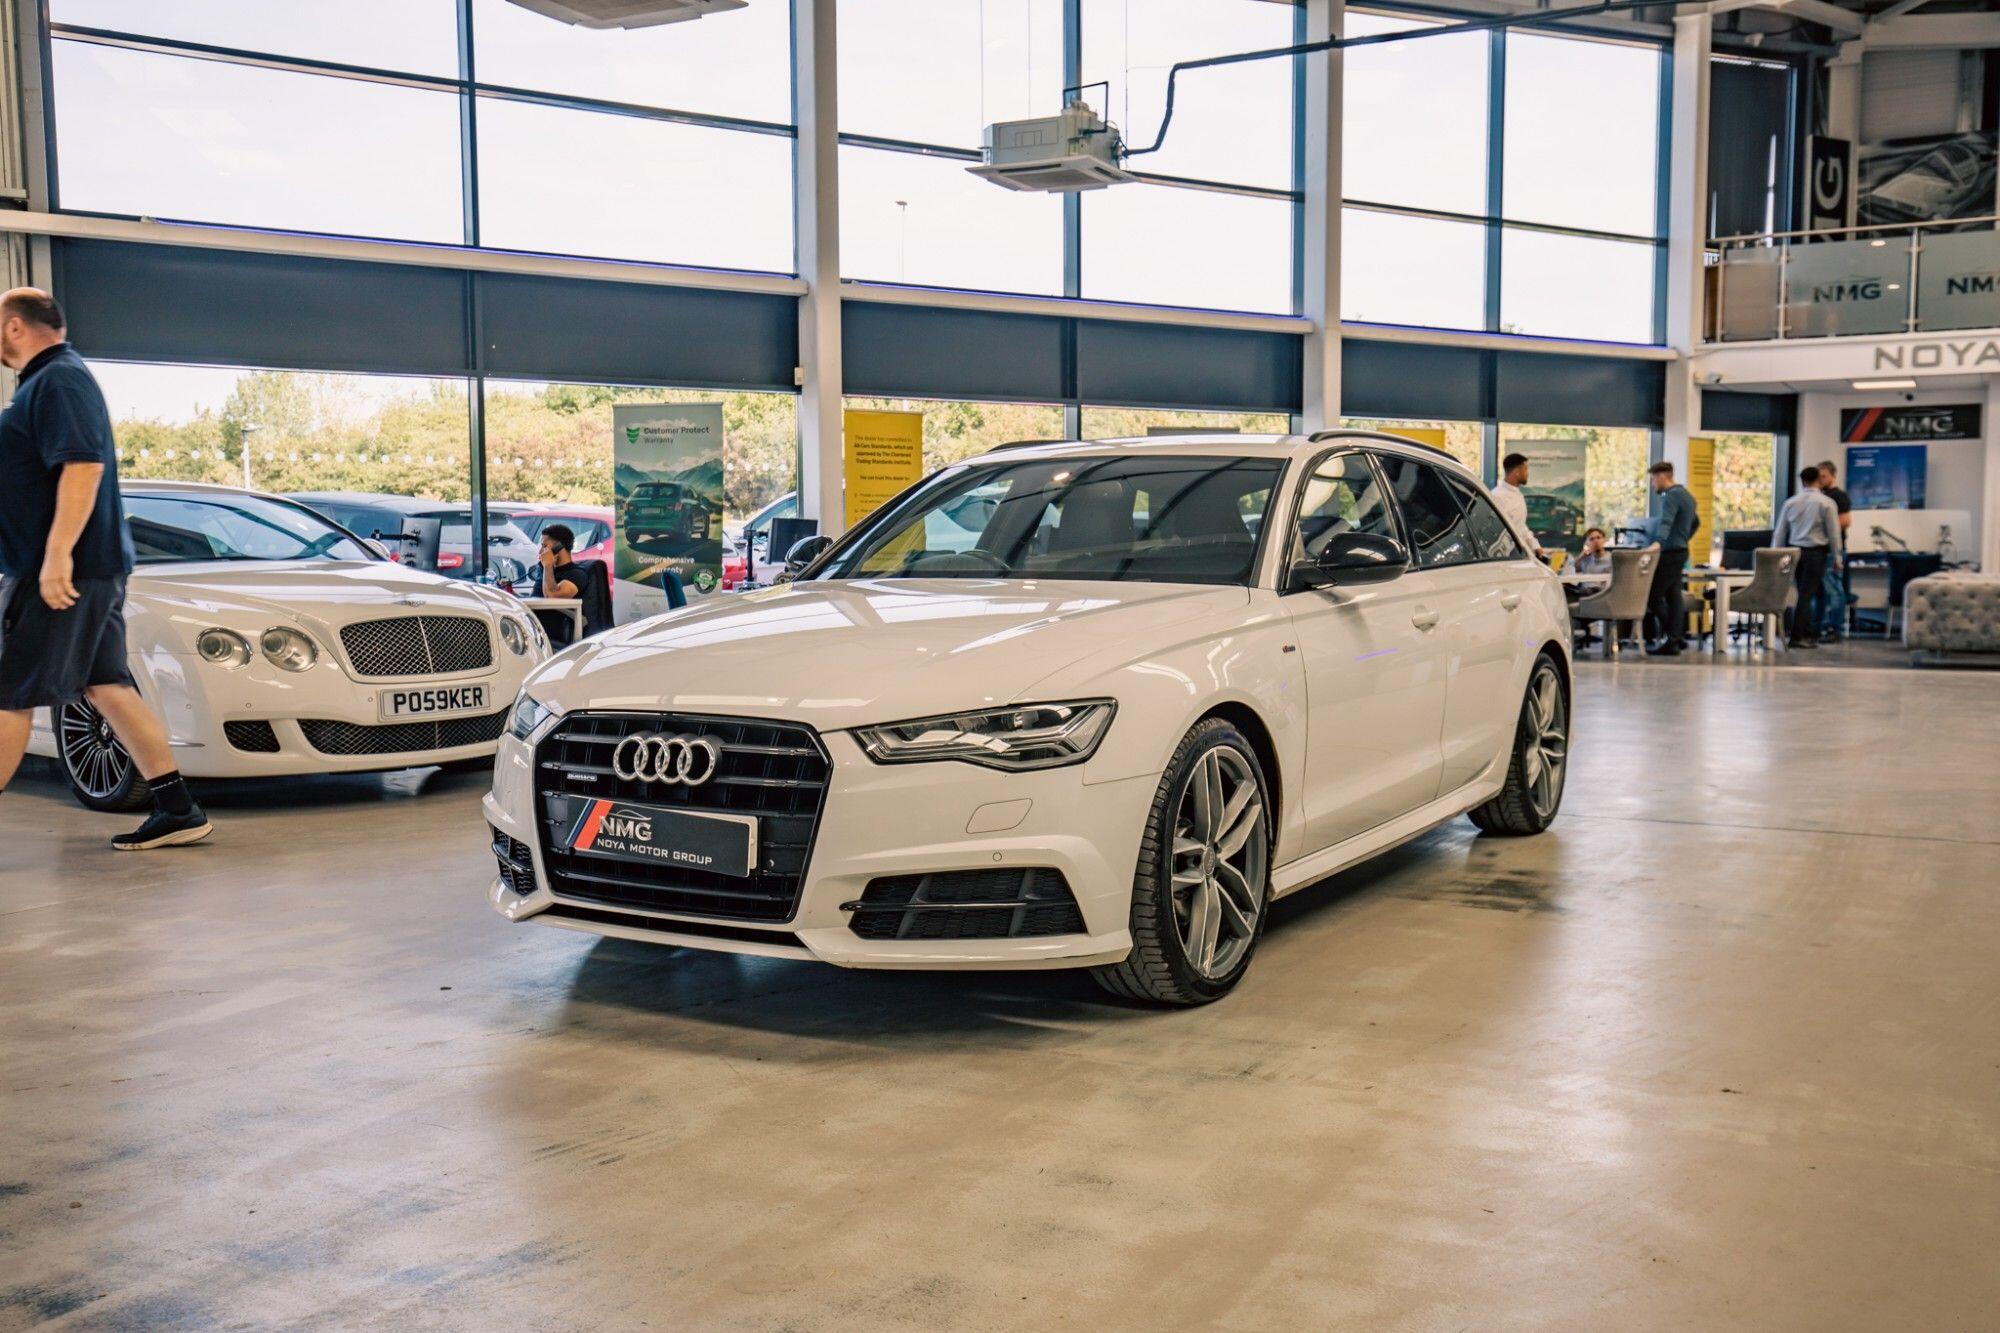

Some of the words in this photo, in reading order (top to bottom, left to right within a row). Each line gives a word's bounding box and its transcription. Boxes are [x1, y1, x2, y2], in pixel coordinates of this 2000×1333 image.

[1813, 282, 1881, 303] NMG
[1946, 275, 2000, 295] NM
[1875, 342, 2000, 370] NOYA
[643, 427, 679, 435] Customer
[681, 426, 709, 434] Protect
[1885, 415, 1954, 434] NMG
[638, 556, 695, 565] Comprehensive
[393, 687, 483, 714] PO59KER
[599, 816, 652, 842] NMG
[597, 838, 626, 851] NOYA
[629, 844, 669, 859] MOTOR
[673, 851, 713, 866] GROUP
